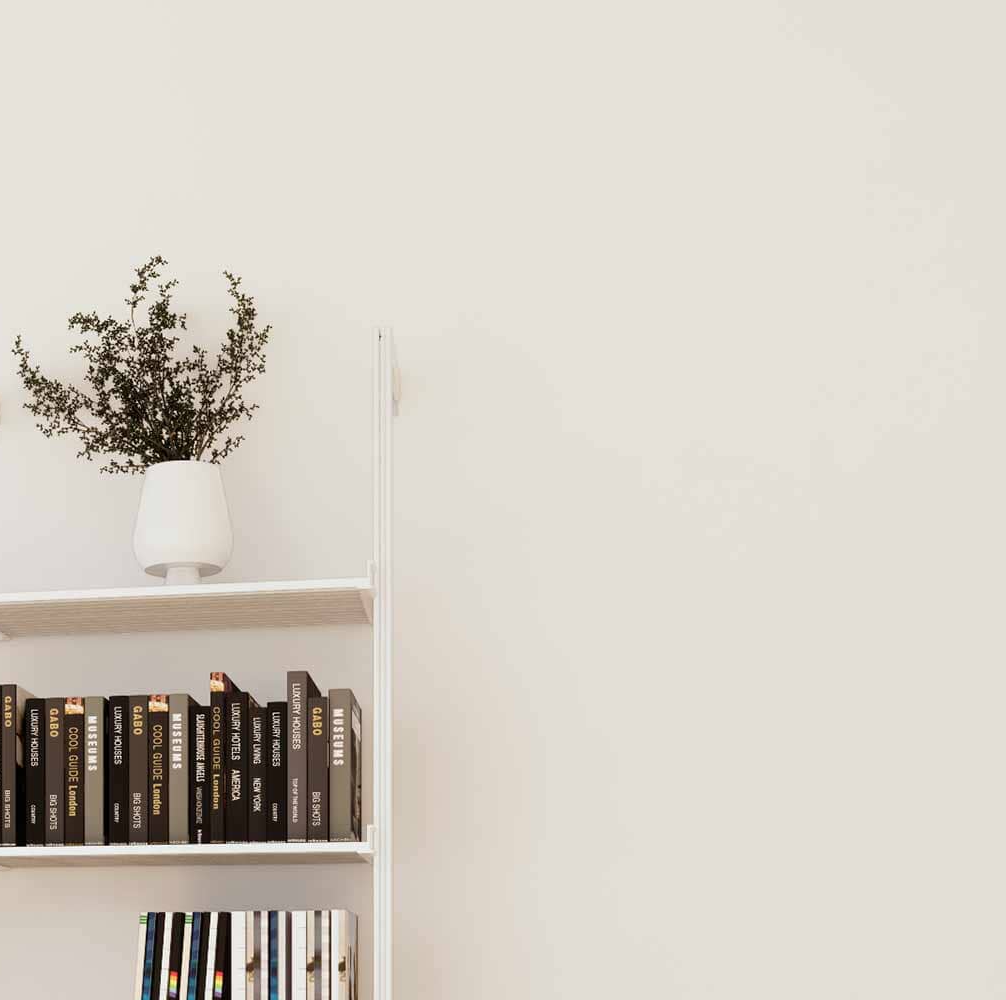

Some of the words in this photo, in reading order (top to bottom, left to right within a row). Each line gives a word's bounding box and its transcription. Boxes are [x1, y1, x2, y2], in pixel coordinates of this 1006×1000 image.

[4, 696, 12, 728] GABO
[292, 683, 301, 714] LUXURY
[30, 709, 39, 736] LUXURY
[50, 708, 59, 737] GABO
[114, 706, 122, 734] LUXURY
[133, 706, 143, 735] GABO
[213, 707, 221, 736] COOL
[232, 703, 240, 732] LUXURY
[272, 712, 280, 738] LUXURY
[312, 707, 322, 736] GABO
[69, 727, 78, 752] COOL
[88, 716, 98, 772] MUSEUMS
[152, 724, 162, 750] COOL
[172, 713, 182, 769] MUSEUMS
[232, 732, 240, 760] HOTELS
[292, 717, 301, 750] HOUSES
[333, 708, 344, 766] MUSEUMS
[30, 738, 39, 767] HOUSES
[114, 736, 122, 765] HOUSES
[213, 739, 221, 770] GUIDE
[272, 740, 280, 767] HOUSES
[69, 755, 78, 782] GUIDE
[152, 752, 162, 781] GUIDE
[133, 792, 141, 804] BIG
[213, 774, 221, 810] London
[232, 769, 240, 801] AMERICA
[253, 778, 261, 792] NEW
[312, 791, 320, 803] BIG
[50, 794, 58, 806] BIG
[69, 785, 78, 816] London
[152, 784, 162, 816] London
[253, 794, 261, 812] YORK
[50, 808, 58, 830] SHOTS
[133, 806, 141, 829] SHOTS
[312, 804, 320, 826] SHOTS
